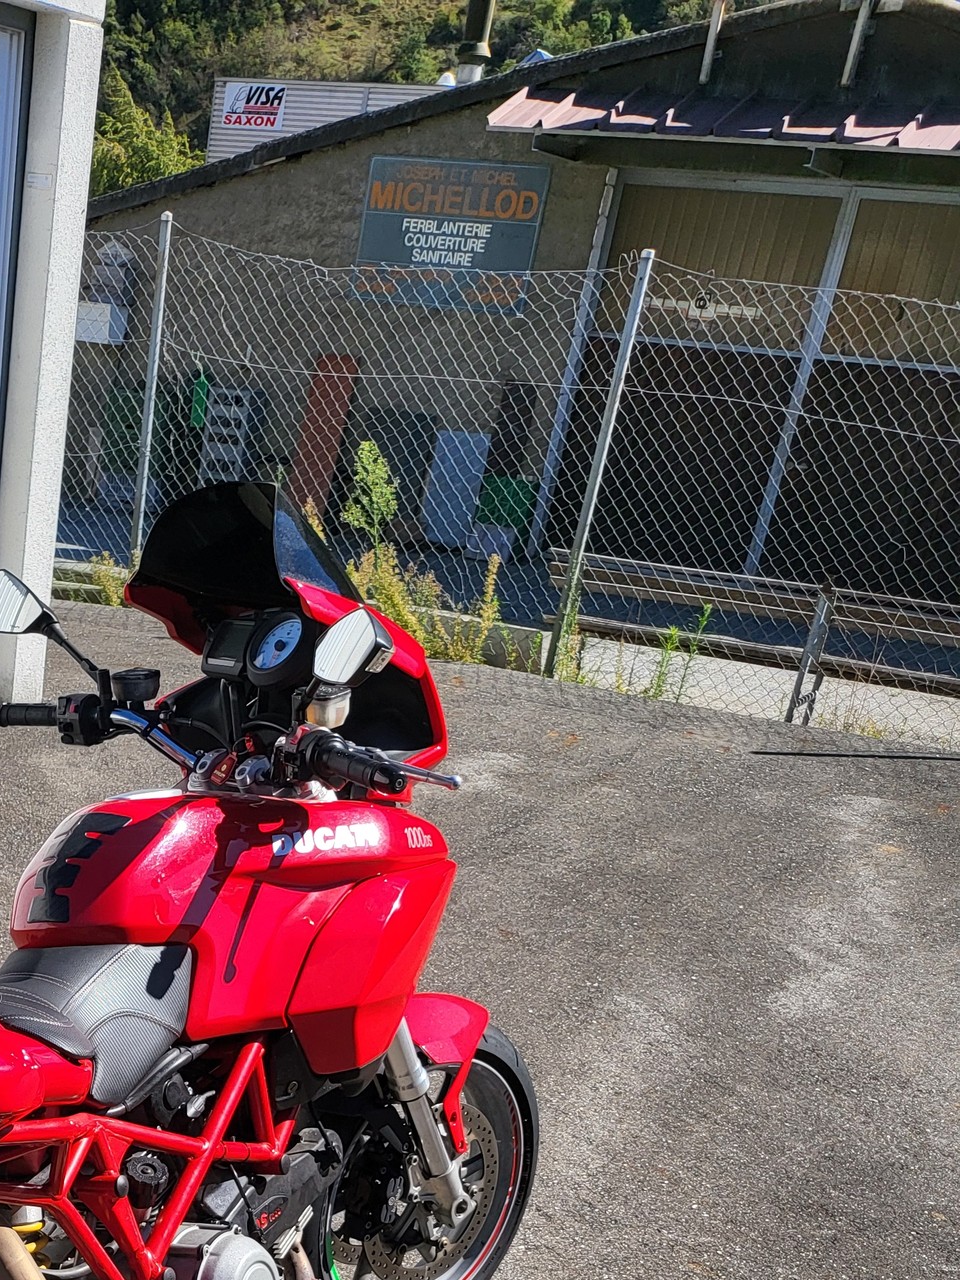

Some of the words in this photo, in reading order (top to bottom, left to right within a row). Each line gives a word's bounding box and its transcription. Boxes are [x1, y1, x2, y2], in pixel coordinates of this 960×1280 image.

[245, 86, 286, 106] VISA
[223, 115, 277, 127] SAXON
[450, 169, 466, 182] ET
[471, 170, 518, 186] MICHEL
[369, 180, 540, 220] MICHELLOD
[402, 218, 493, 238] FERBLANTERIE
[404, 233, 487, 252] COUVERTURE
[411, 248, 474, 266] SANITAIRE
[271, 823, 381, 857] DUCATI
